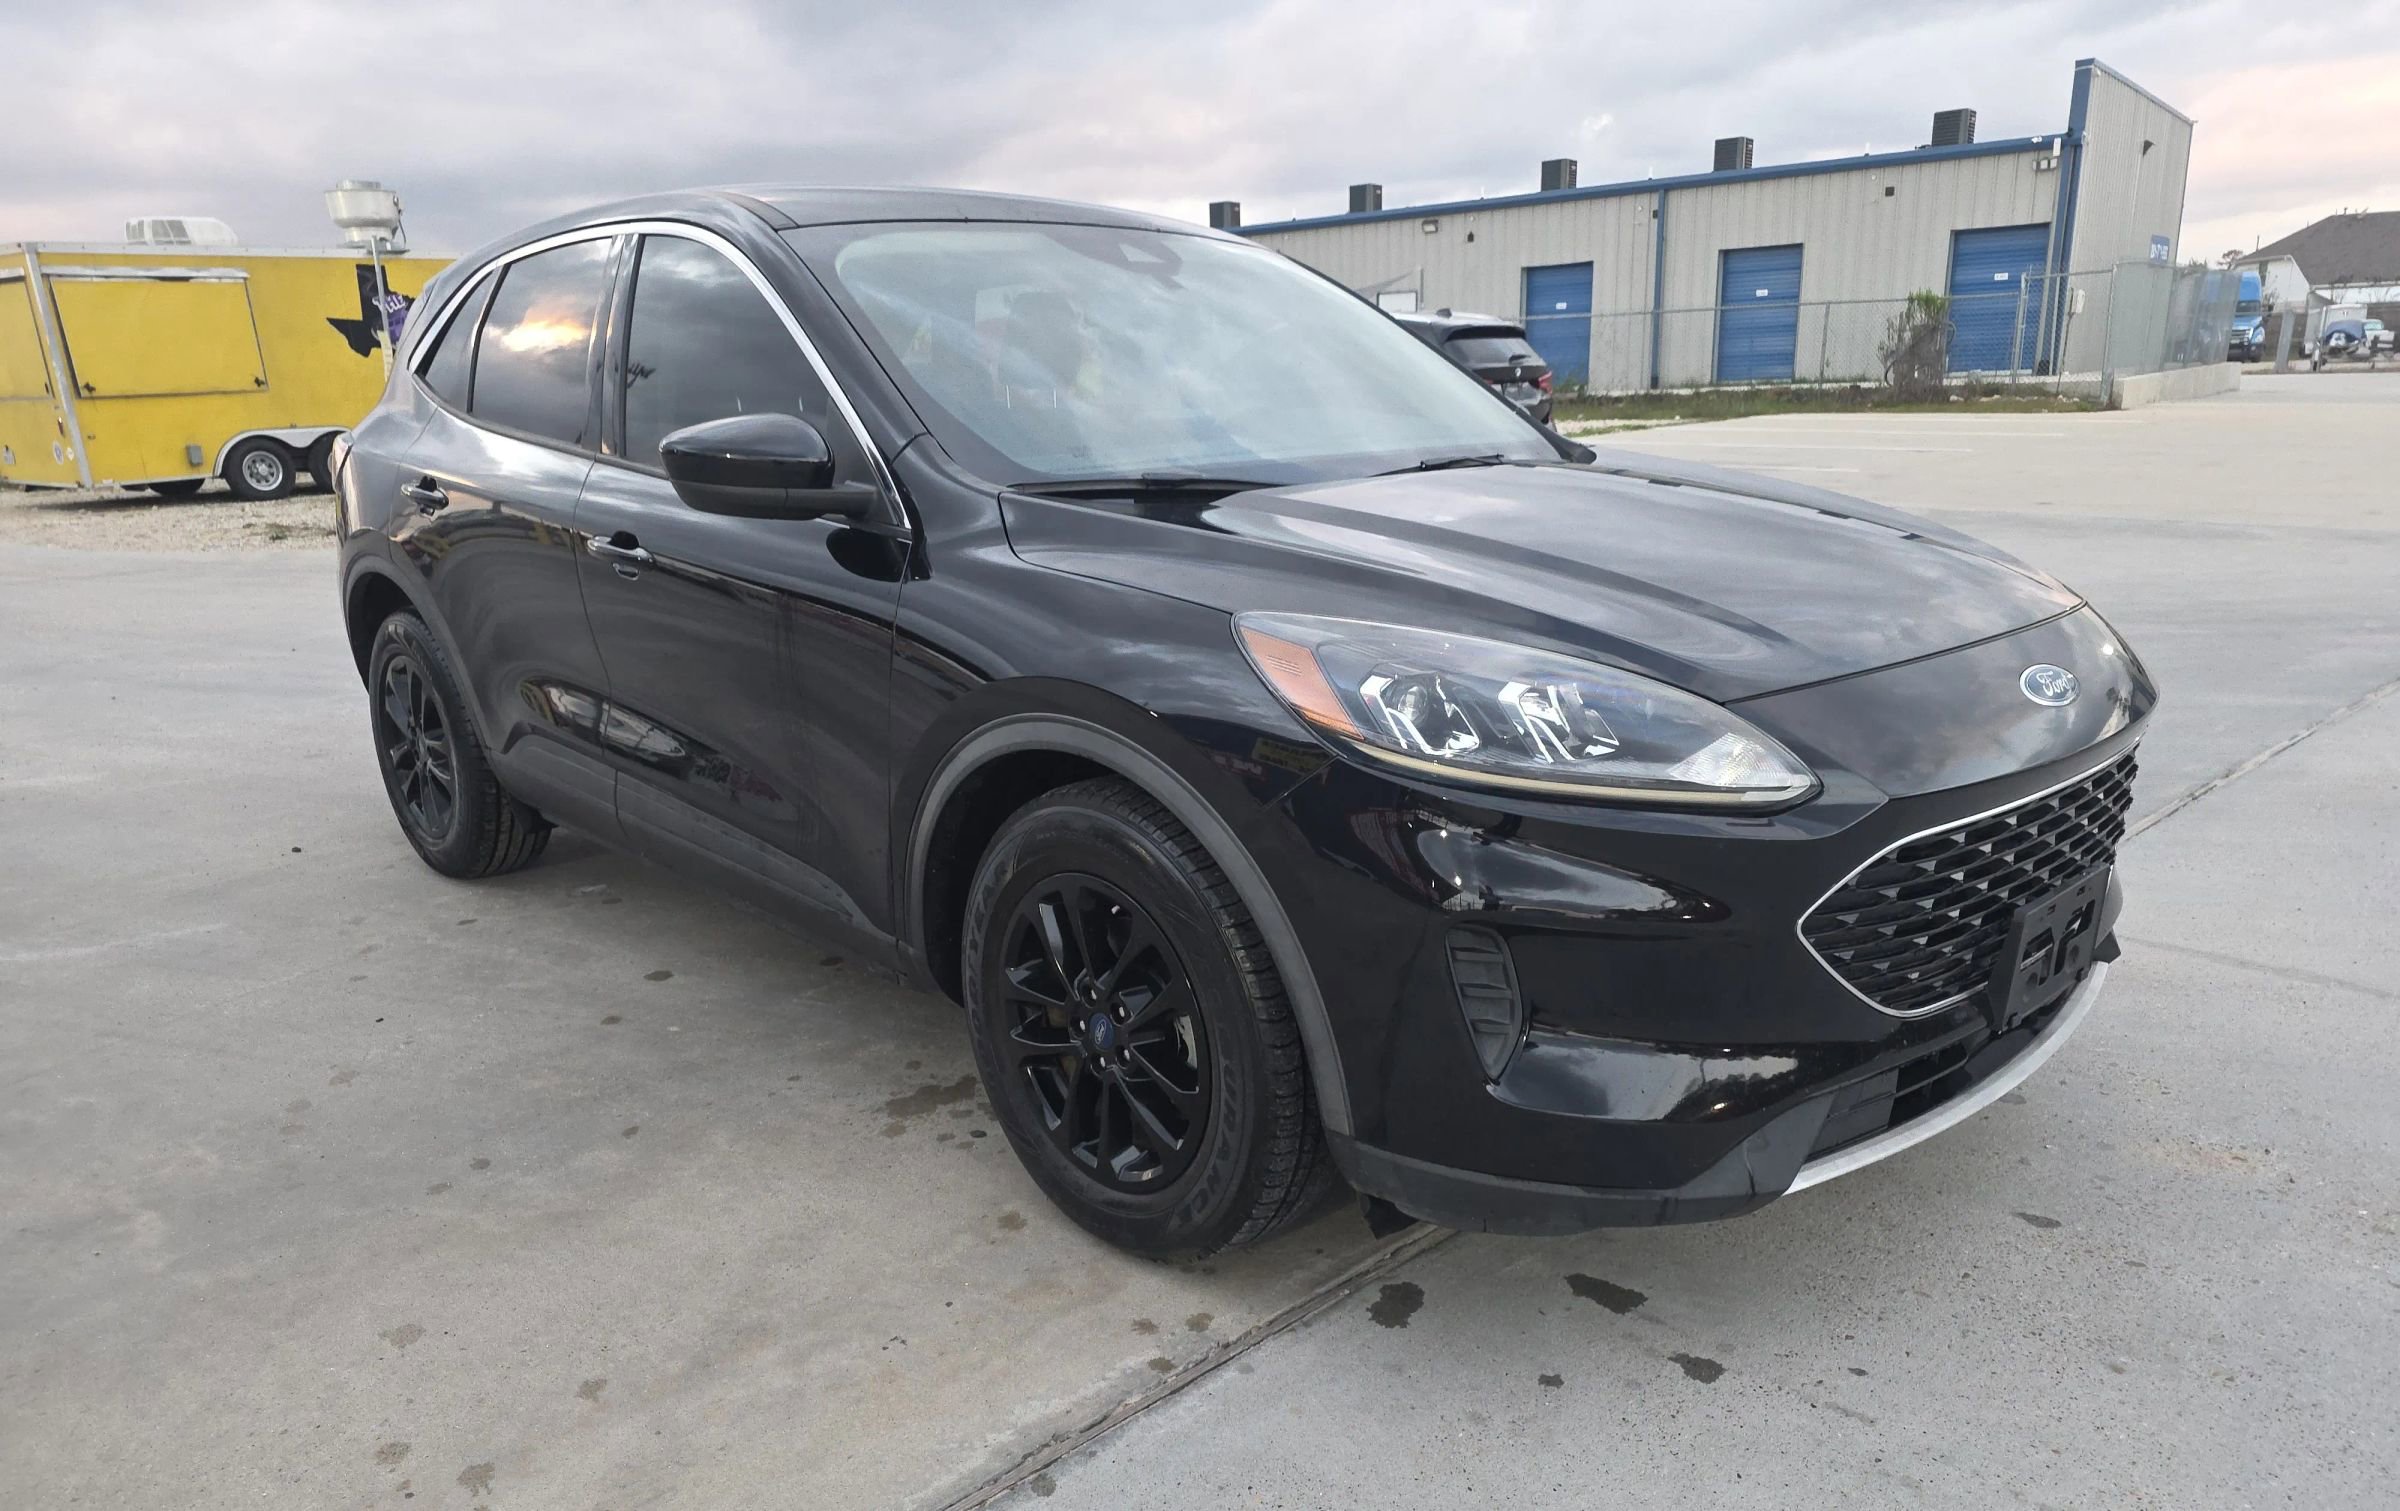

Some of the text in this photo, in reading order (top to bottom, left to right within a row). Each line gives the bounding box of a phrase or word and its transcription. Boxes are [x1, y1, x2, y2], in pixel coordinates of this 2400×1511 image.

[2036, 670, 2071, 697] Ford
[967, 856, 1009, 1086] ODYEAR
[1175, 985, 1238, 1226] URANCE
